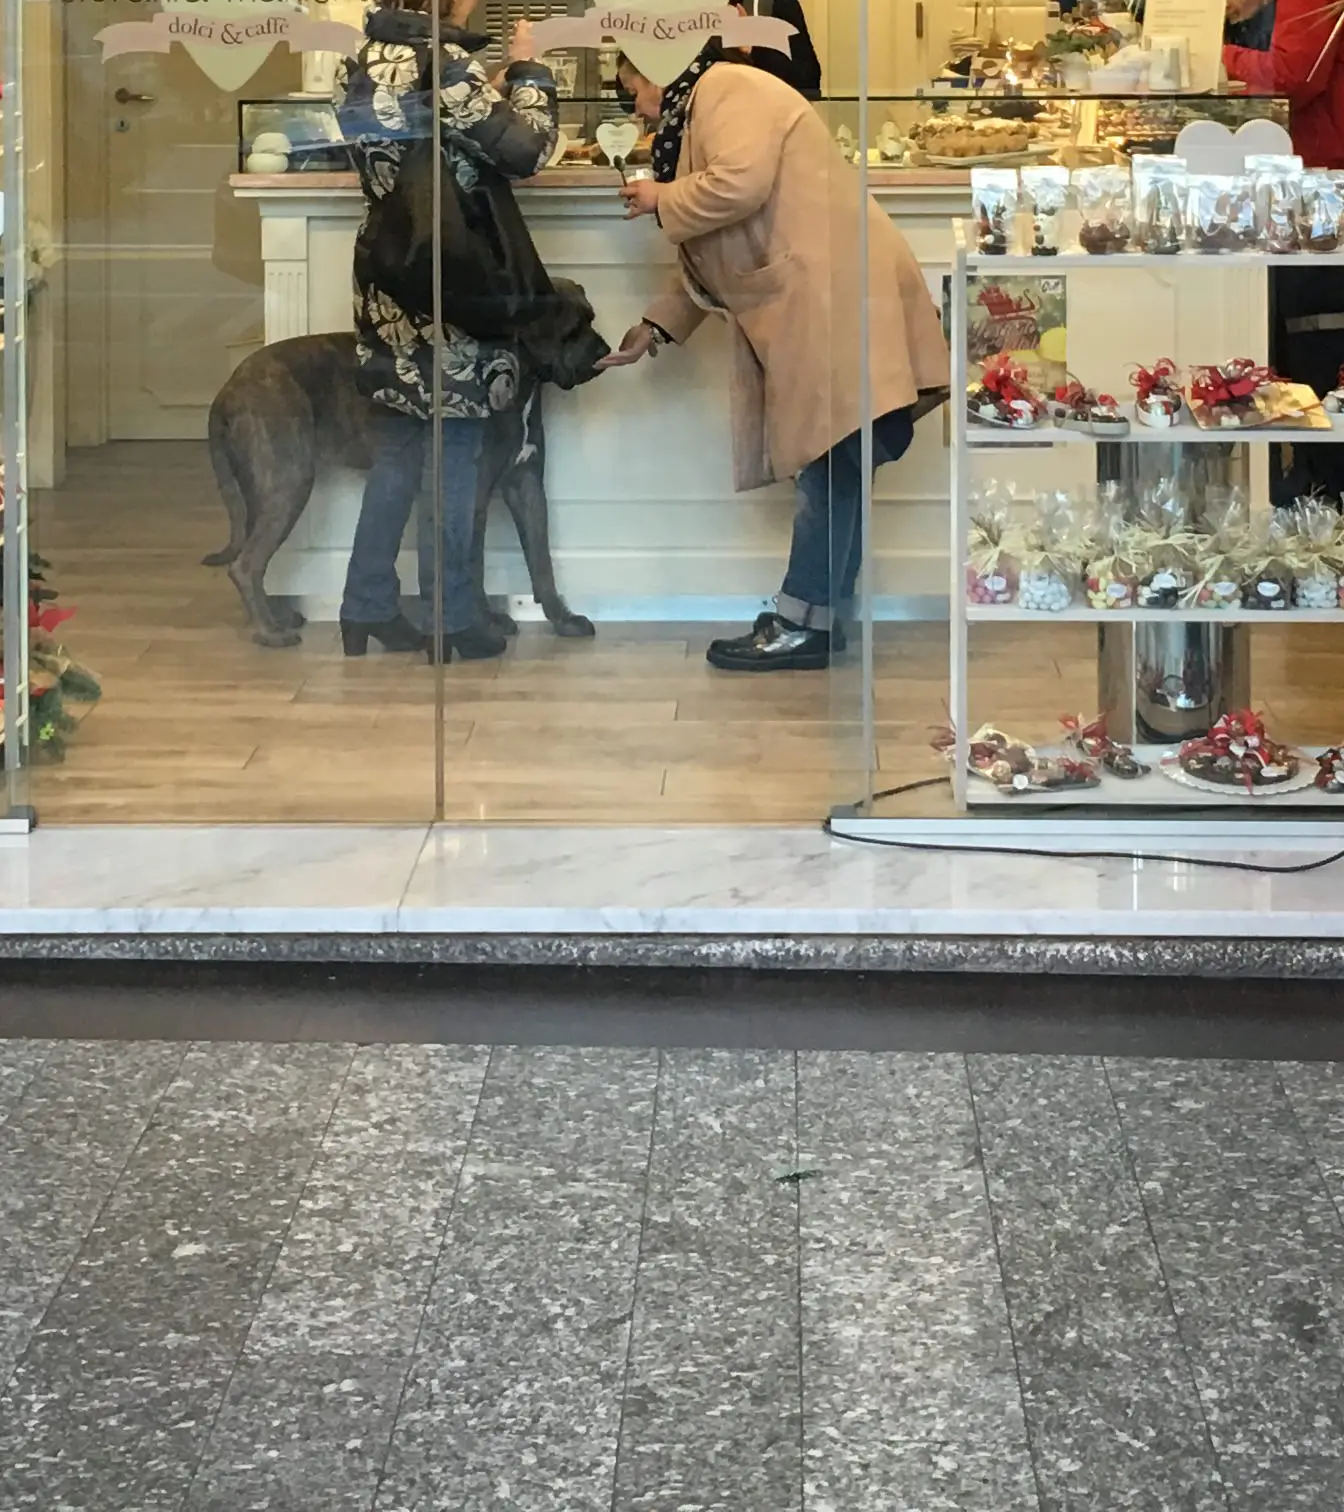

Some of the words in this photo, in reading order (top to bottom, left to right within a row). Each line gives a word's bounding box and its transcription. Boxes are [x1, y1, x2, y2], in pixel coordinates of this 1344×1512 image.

[168, 17, 214, 39] dolci
[220, 20, 243, 45] &
[244, 17, 290, 39] caffè
[599, 12, 647, 33] dolci
[652, 16, 677, 40] &
[677, 12, 723, 33] caffè
